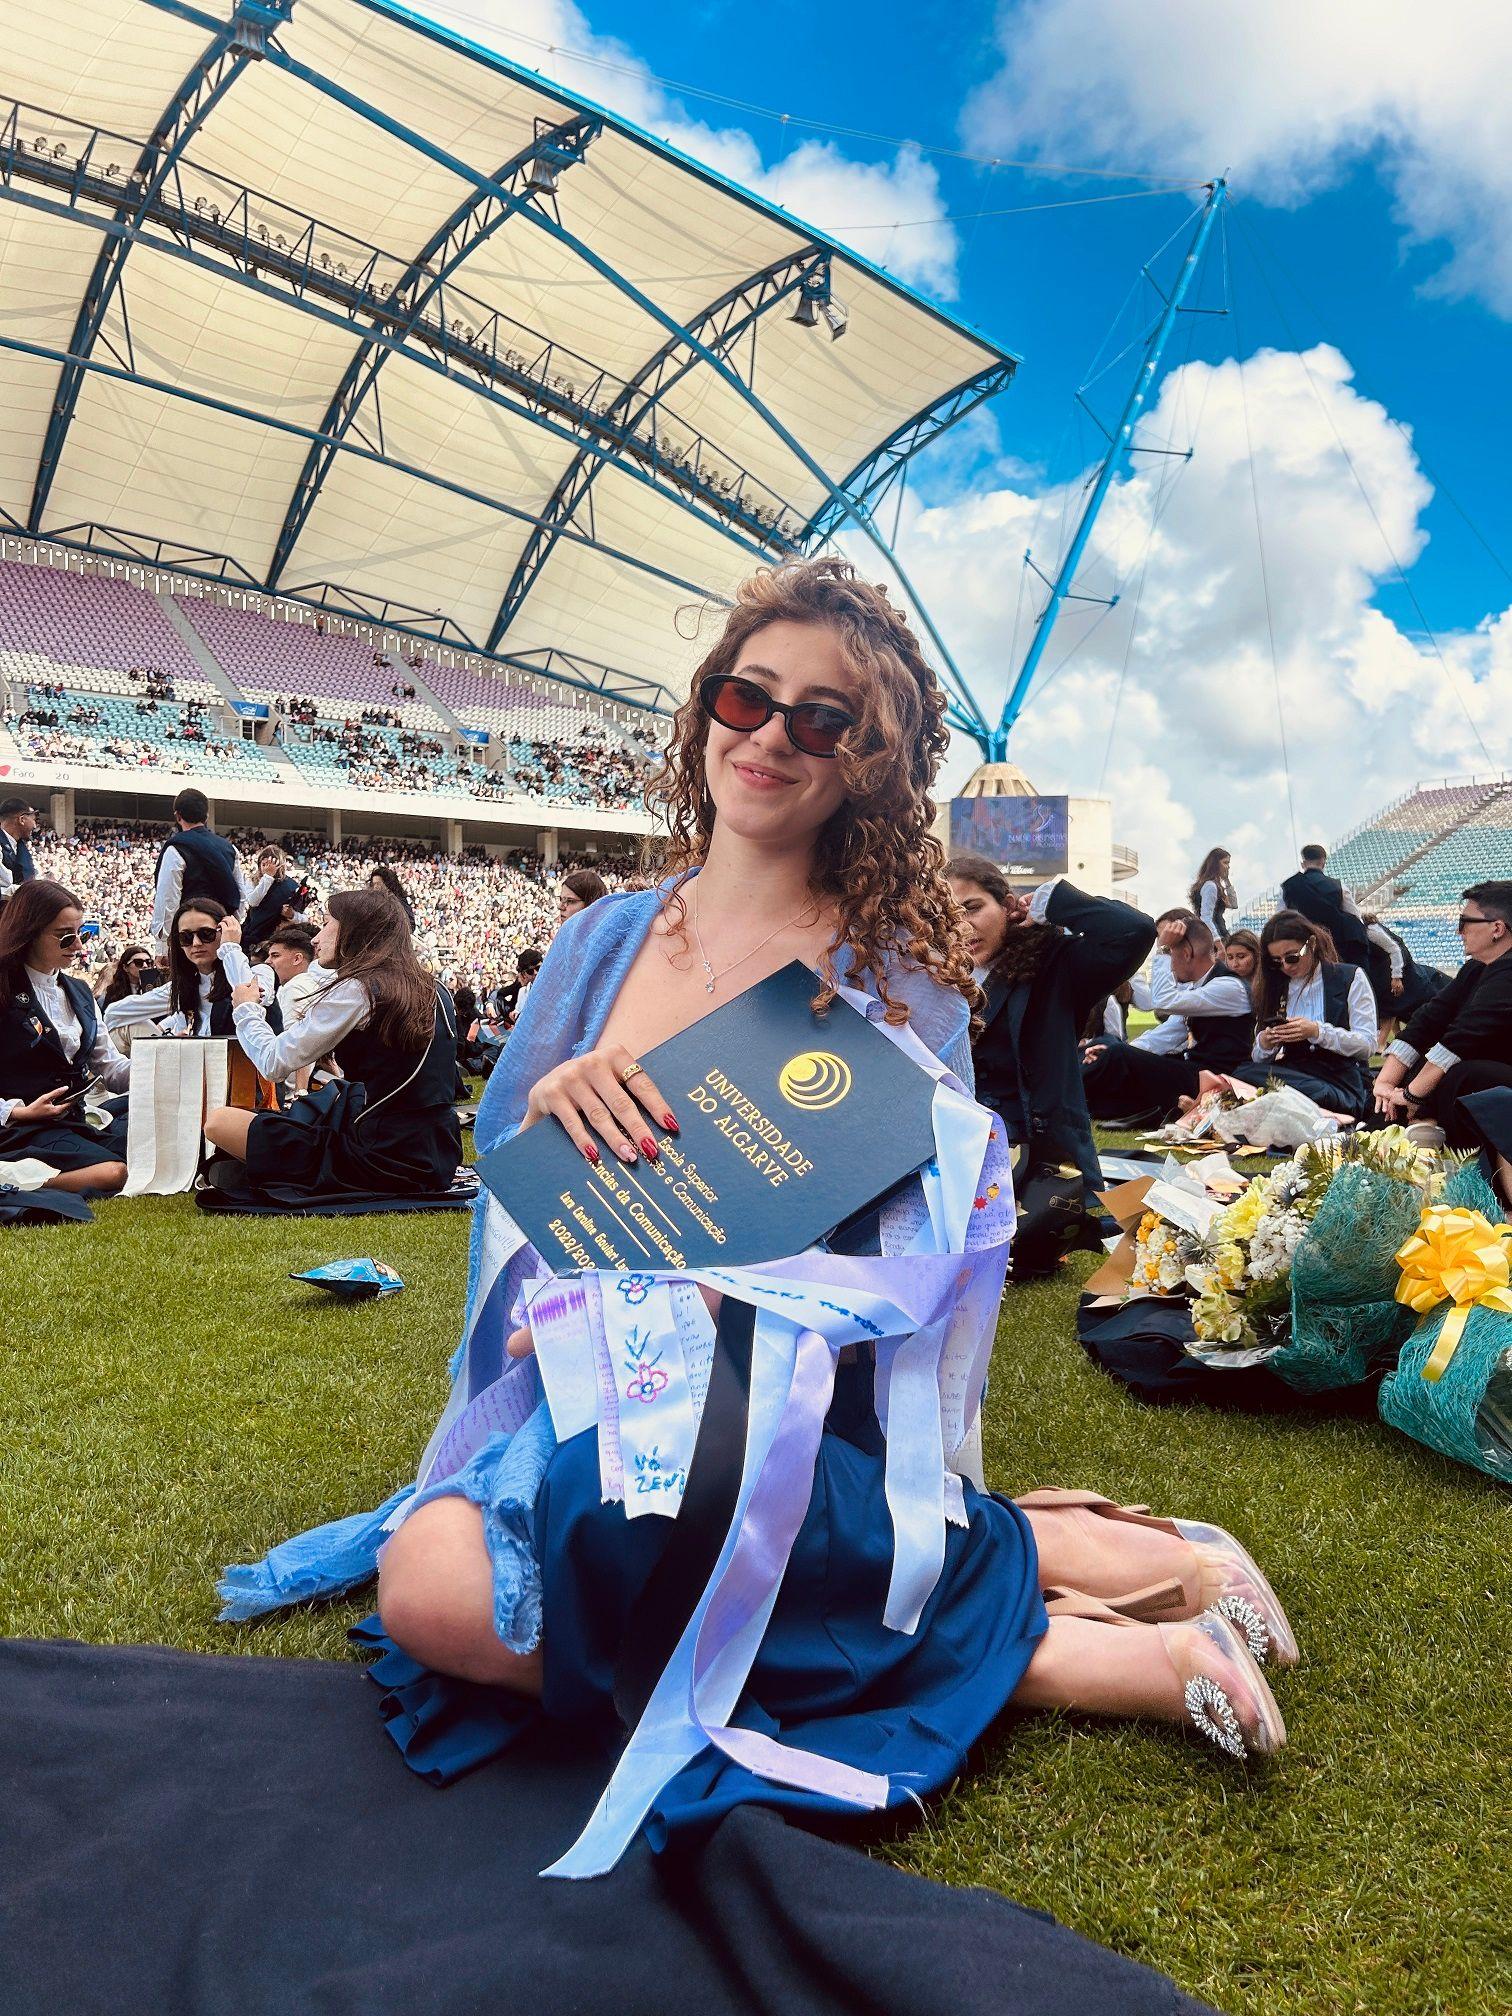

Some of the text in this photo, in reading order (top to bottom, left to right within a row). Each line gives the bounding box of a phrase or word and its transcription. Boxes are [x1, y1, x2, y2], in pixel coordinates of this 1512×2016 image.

[13, 768, 35, 779] Faro
[687, 1085, 790, 1187] DO ALGARVE
[705, 1068, 814, 1177] UNIVERSIDADE
[658, 1136, 719, 1203] Escola Superior
[573, 1206, 597, 1236] Caroline
[594, 1232, 620, 1261] Goulart
[616, 1190, 631, 1206] da
[629, 1203, 687, 1269] Comunicação
[664, 1176, 674, 1185] e
[672, 1182, 727, 1244] Comunicação
